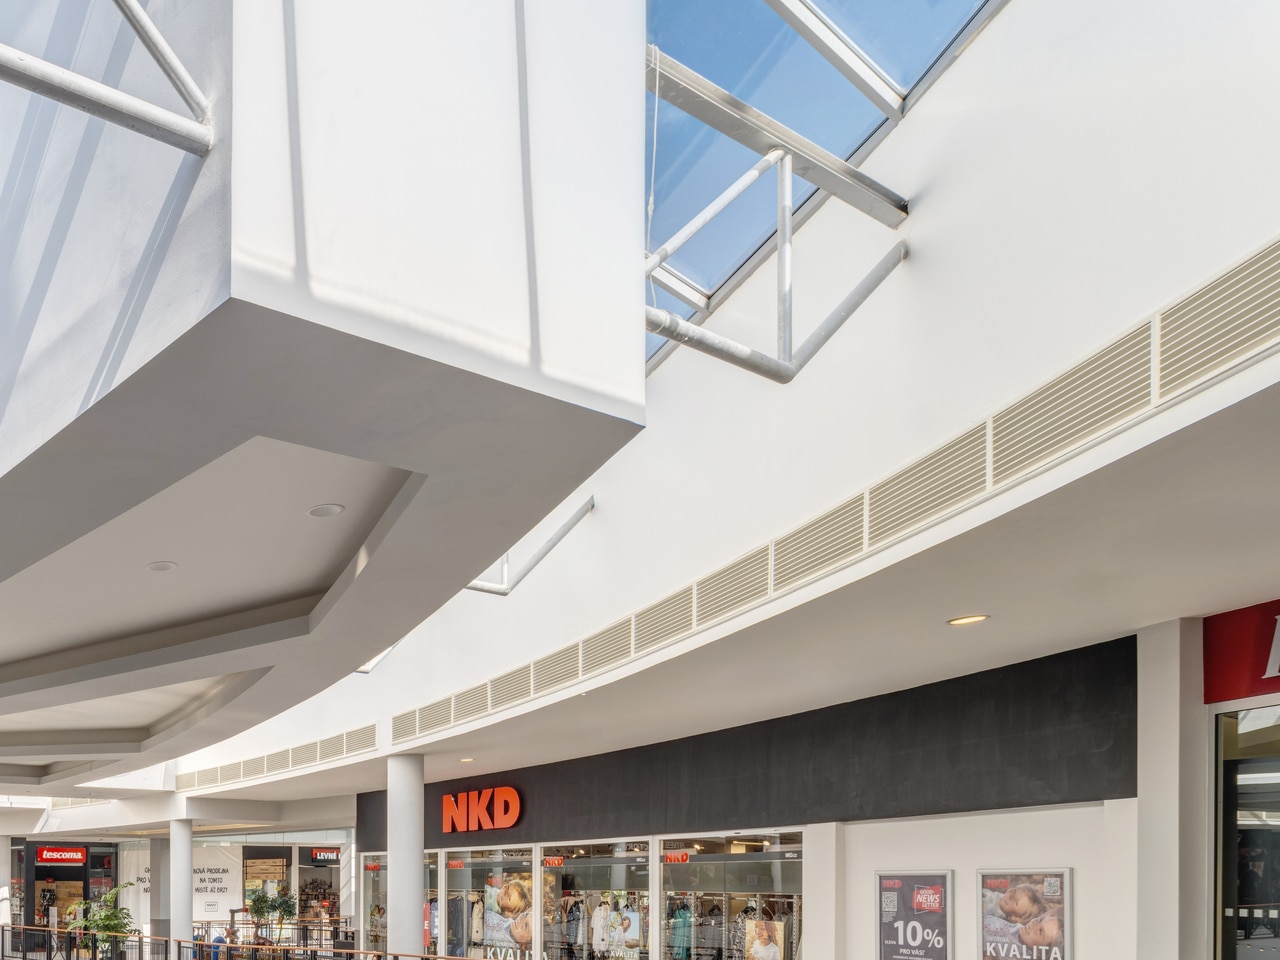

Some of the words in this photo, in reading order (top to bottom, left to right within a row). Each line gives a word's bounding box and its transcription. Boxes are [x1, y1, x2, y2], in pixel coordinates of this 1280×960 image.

[442, 786, 520, 833] NKD
[316, 850, 337, 860] LEVNÉ
[665, 852, 689, 863] NKD
[448, 860, 465, 869] NKD
[544, 857, 563, 867] NKD
[985, 879, 1010, 889] NKD
[916, 894, 940, 903] NEWS
[893, 920, 944, 949] 10%
[610, 951, 638, 960] KVALITA
